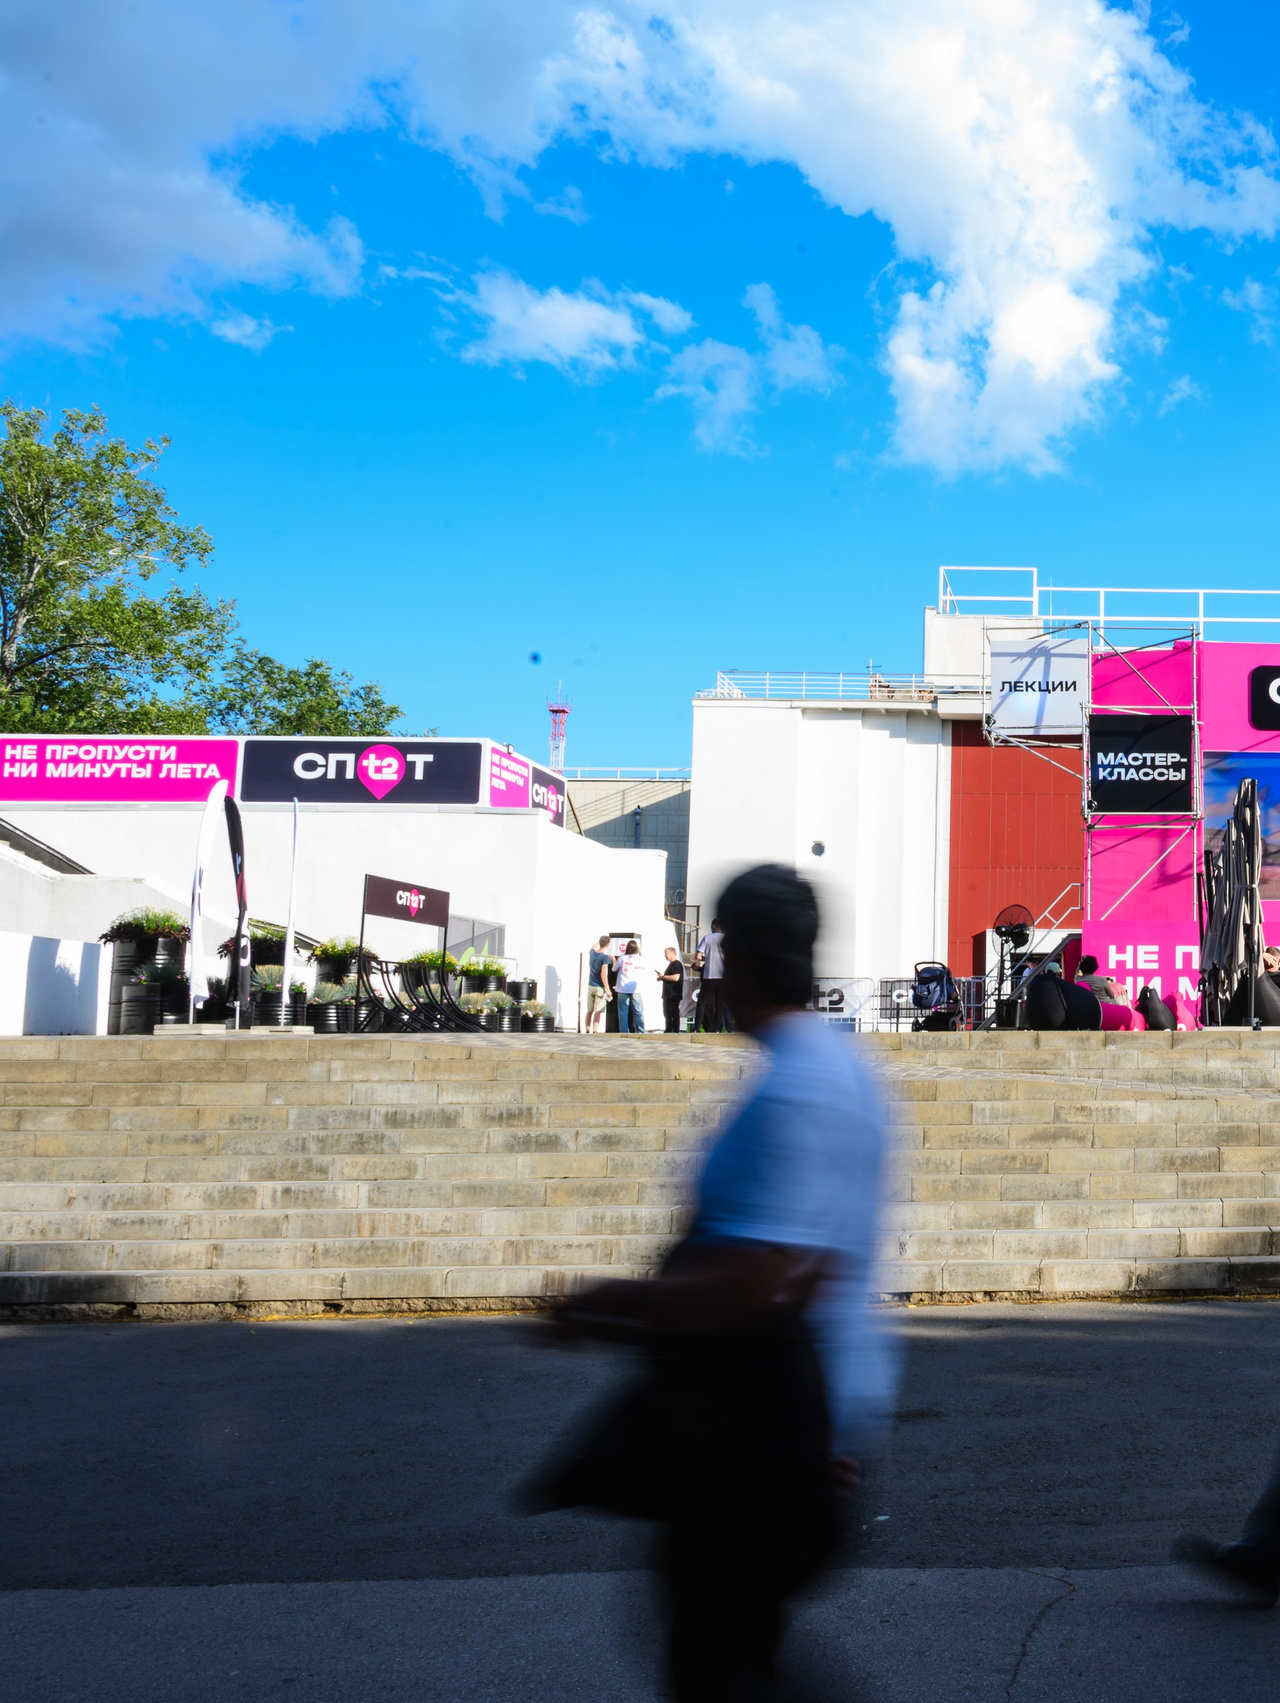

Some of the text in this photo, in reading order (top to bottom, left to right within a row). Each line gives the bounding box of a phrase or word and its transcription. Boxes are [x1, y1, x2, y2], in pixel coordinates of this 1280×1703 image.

[1000, 680, 1077, 694] ЛЕКЦИИ
[4, 744, 177, 760] НЕ ПРОПУСТИ
[1096, 752, 1188, 766] МАСТЕР-
[3, 763, 221, 778] НИ МИНУТЫ ЛЕТА
[1098, 767, 1186, 781] КЛАССЫ
[1108, 945, 1159, 969] НЕ
